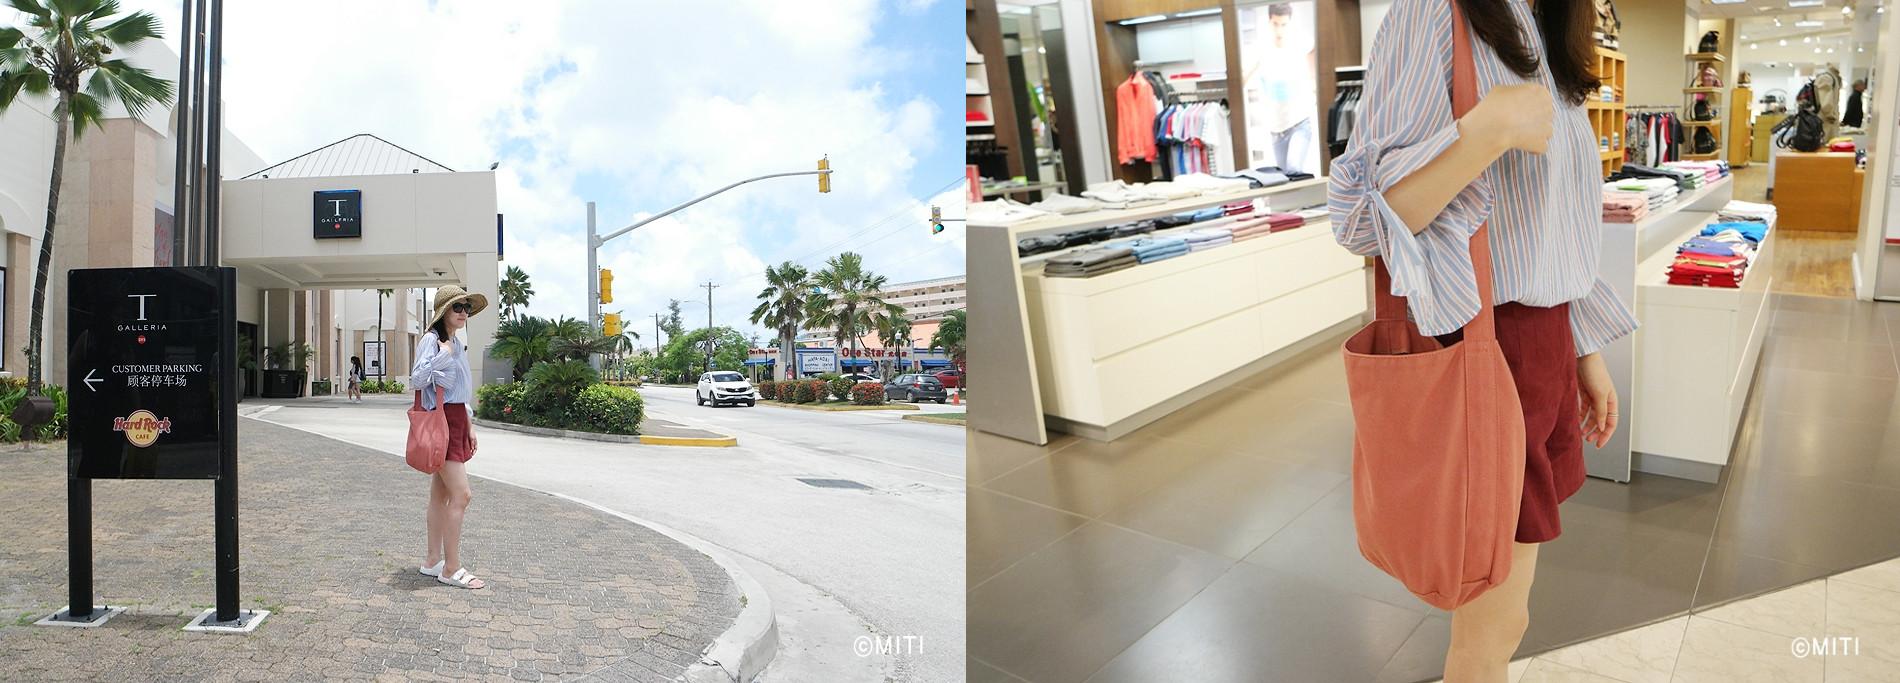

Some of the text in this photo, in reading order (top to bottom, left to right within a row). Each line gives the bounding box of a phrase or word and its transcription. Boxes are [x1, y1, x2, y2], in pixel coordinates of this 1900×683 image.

[328, 199, 347, 216] T
[127, 294, 157, 321] T
[117, 324, 167, 332] GALLERIA
[112, 364, 203, 373] CUSTOMER PARKING
[127, 374, 187, 387] 顾客停车场
[113, 417, 171, 433] Hard Rock
